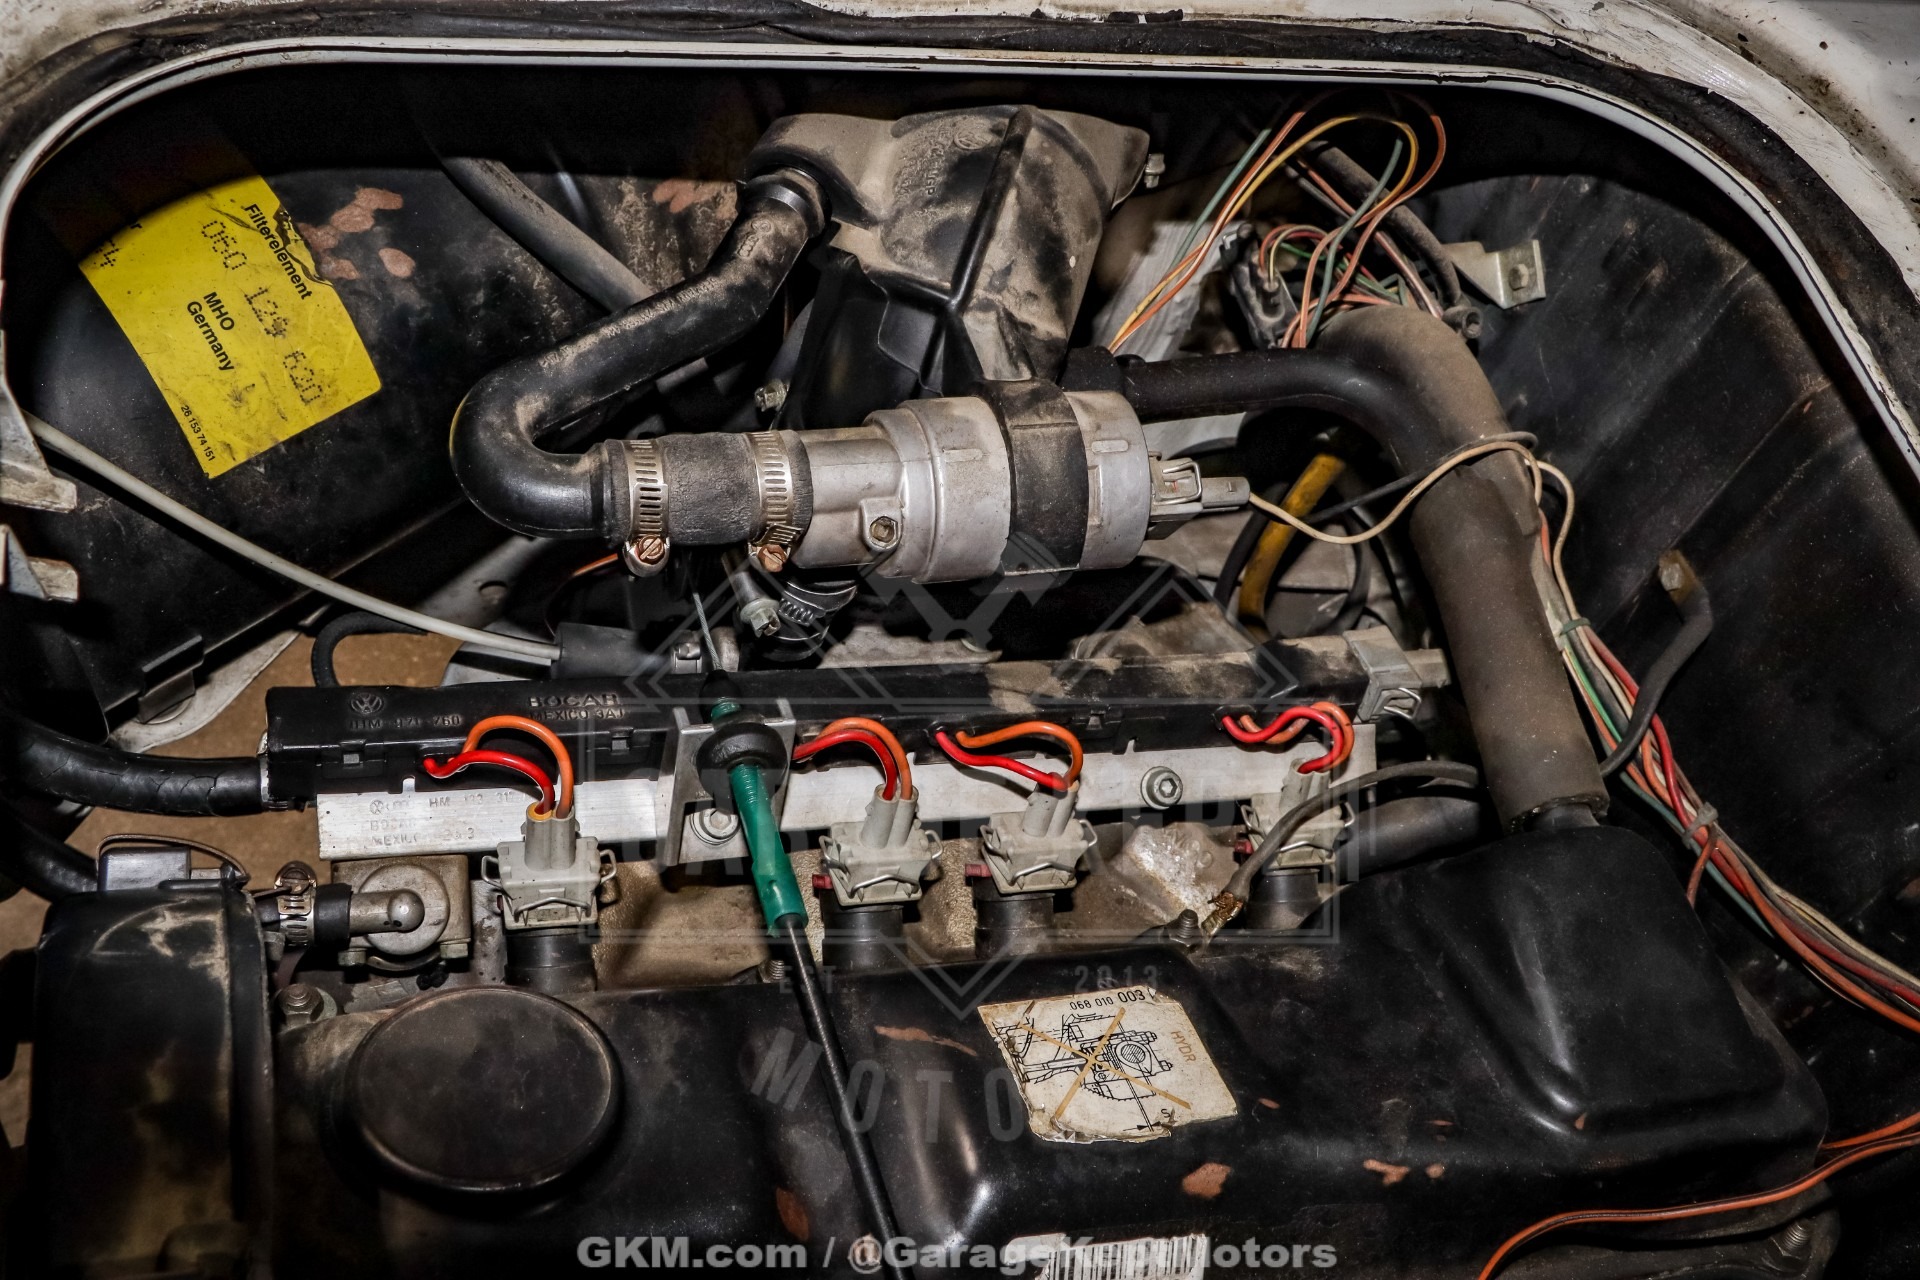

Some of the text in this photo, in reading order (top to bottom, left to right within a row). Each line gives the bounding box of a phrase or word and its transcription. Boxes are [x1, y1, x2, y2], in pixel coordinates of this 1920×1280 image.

[244, 203, 312, 300] Filterelement
[203, 291, 235, 331] MHO
[187, 300, 234, 372] Germany
[181, 405, 216, 461] 26 153 74 151
[529, 693, 619, 708] BOCAR
[530, 708, 590, 721] MEXICO
[1070, 989, 1146, 1011] 068 010 003
[1171, 1030, 1197, 1063] HYDR
